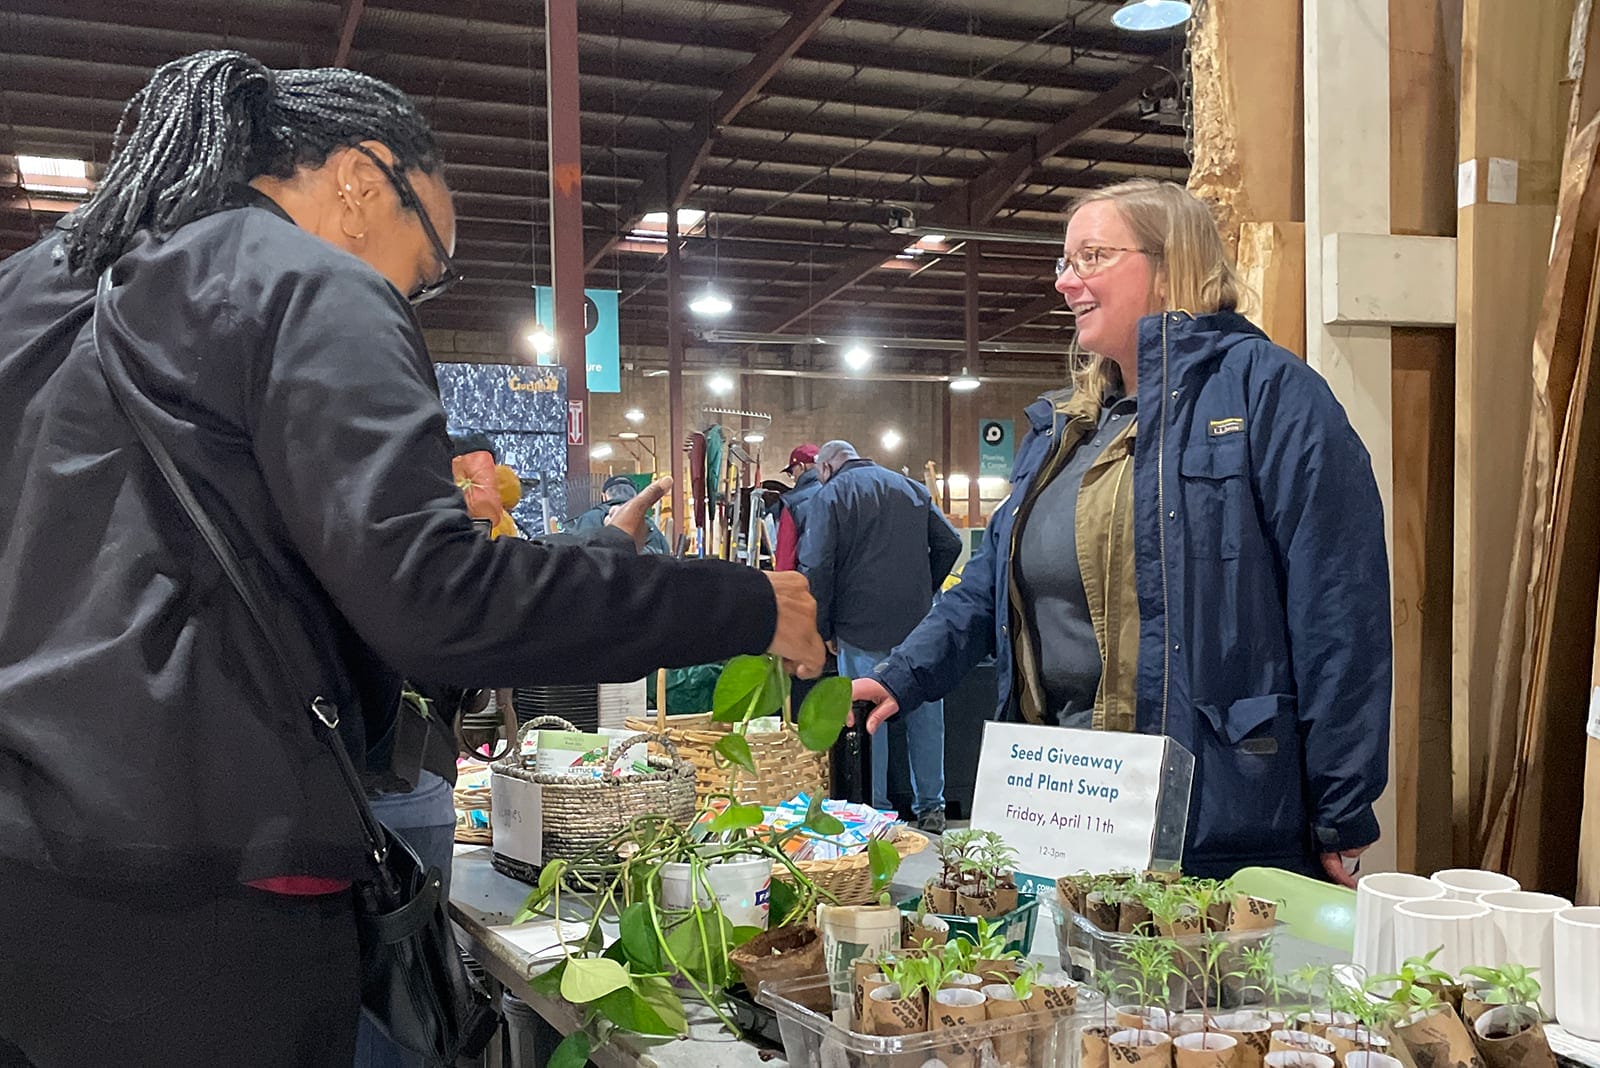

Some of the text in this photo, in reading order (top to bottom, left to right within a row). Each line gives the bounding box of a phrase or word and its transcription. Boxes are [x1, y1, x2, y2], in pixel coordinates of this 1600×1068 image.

[1010, 743, 1123, 775] Seed Giveaway
[1007, 772, 1119, 803] and Plant Swap
[1006, 804, 1114, 834] Friday, April 11th
[1039, 846, 1066, 859] 12-3pm
